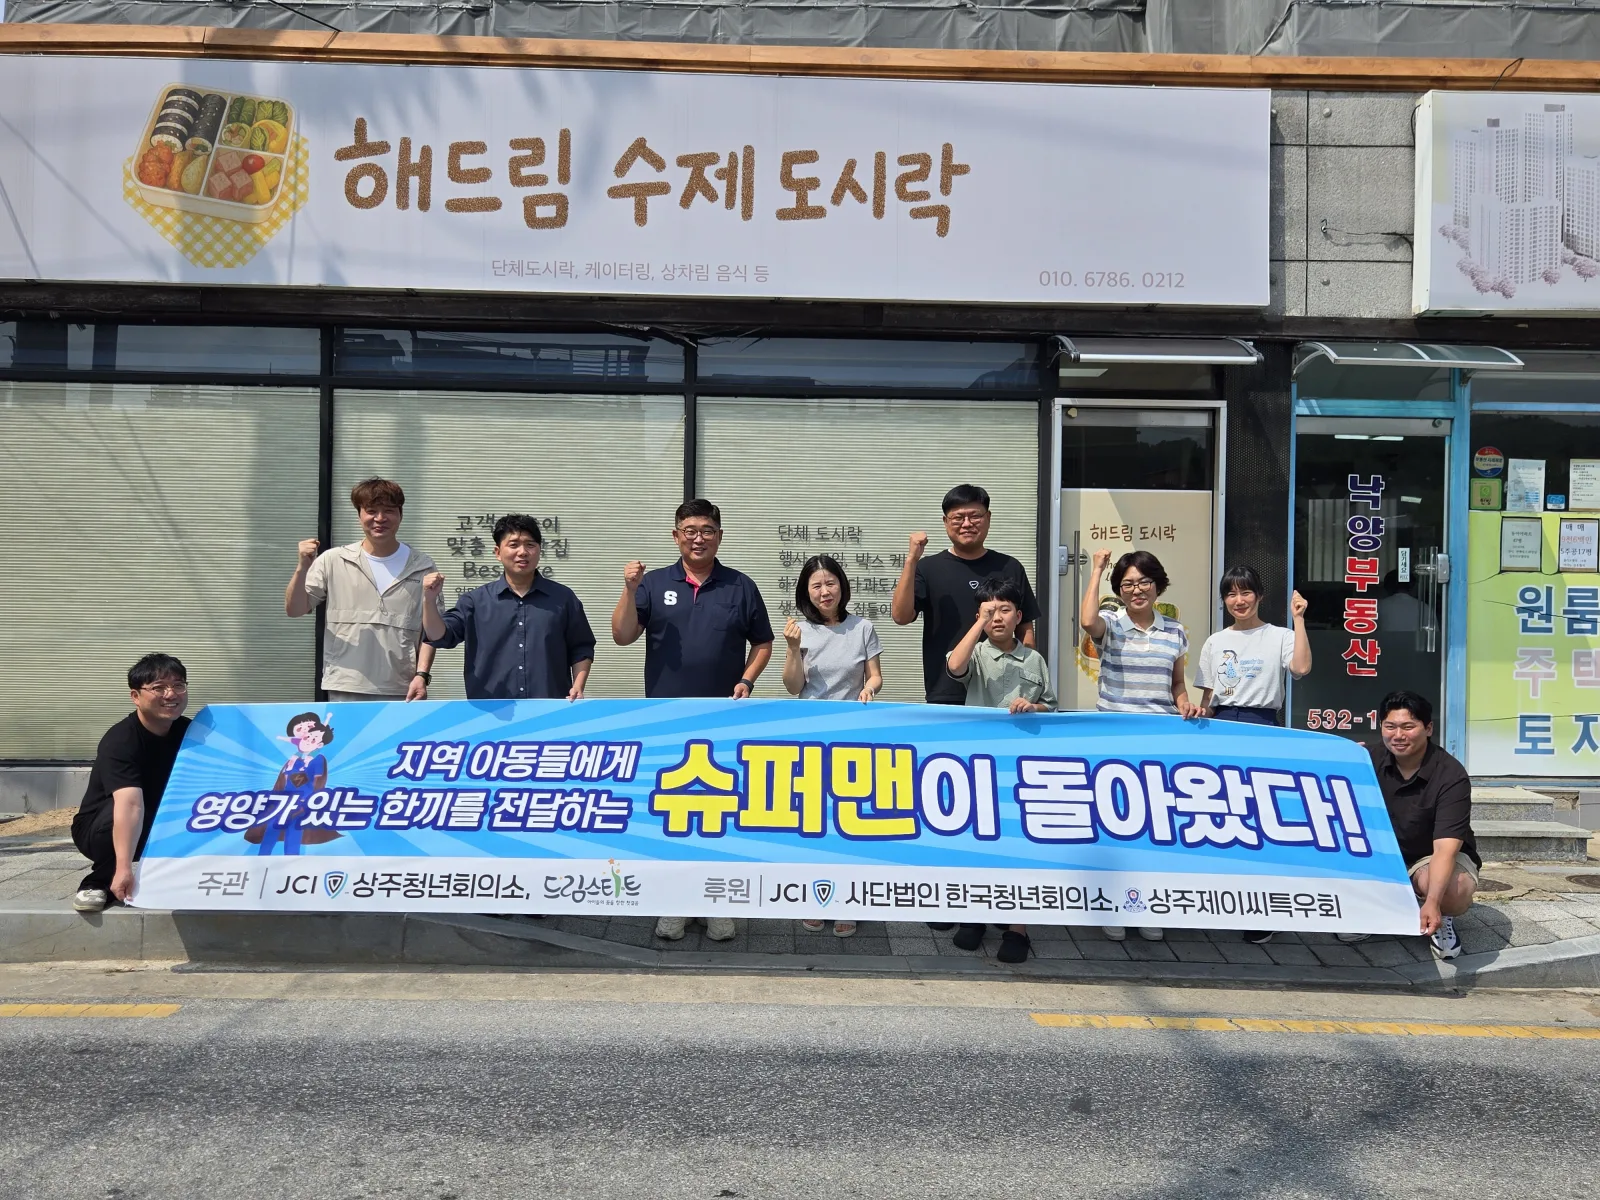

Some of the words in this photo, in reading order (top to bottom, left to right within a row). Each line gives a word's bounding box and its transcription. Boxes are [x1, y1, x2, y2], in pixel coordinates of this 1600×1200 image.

[334, 117, 571, 229] 해드림
[607, 136, 756, 227] 수제
[776, 142, 970, 237] 도시락
[491, 259, 579, 280] 단체도시락,
[584, 262, 655, 281] 케이터링,
[660, 263, 710, 282] 상차림
[715, 264, 748, 282] 음식
[753, 265, 770, 283] 등
[1039, 270, 1078, 287] 010.
[1084, 271, 1135, 288] 6786.
[1142, 272, 1185, 288] 0212
[778, 525, 808, 542] 단체
[815, 526, 862, 543] 도시락
[1089, 523, 1133, 542] 해드림
[1139, 524, 1176, 542] 도시락
[447, 536, 485, 556] 맞춤
[855, 553, 885, 569] 박스
[664, 590, 678, 606] S
[1307, 708, 1378, 730] 532-1
[393, 741, 465, 780] 지역
[469, 742, 641, 781] 아동들에게
[651, 741, 999, 839] 슈퍼맨이
[1017, 758, 1371, 855] 돌아왔다!
[188, 791, 301, 832] 영양가
[300, 790, 376, 829] 있는
[375, 789, 485, 829] 한끼를
[492, 789, 630, 831] 전달하는
[197, 871, 250, 897] 주관
[276, 874, 317, 895] JCI
[352, 872, 531, 901] 상주청년회의소,
[543, 866, 642, 903] 드림스타트
[703, 877, 751, 904] 후원
[769, 883, 807, 904] JCI
[845, 881, 940, 908] 사단법인
[945, 882, 1119, 913] 한국청년회의소,
[1149, 888, 1343, 919] 상주제이씨특우회
